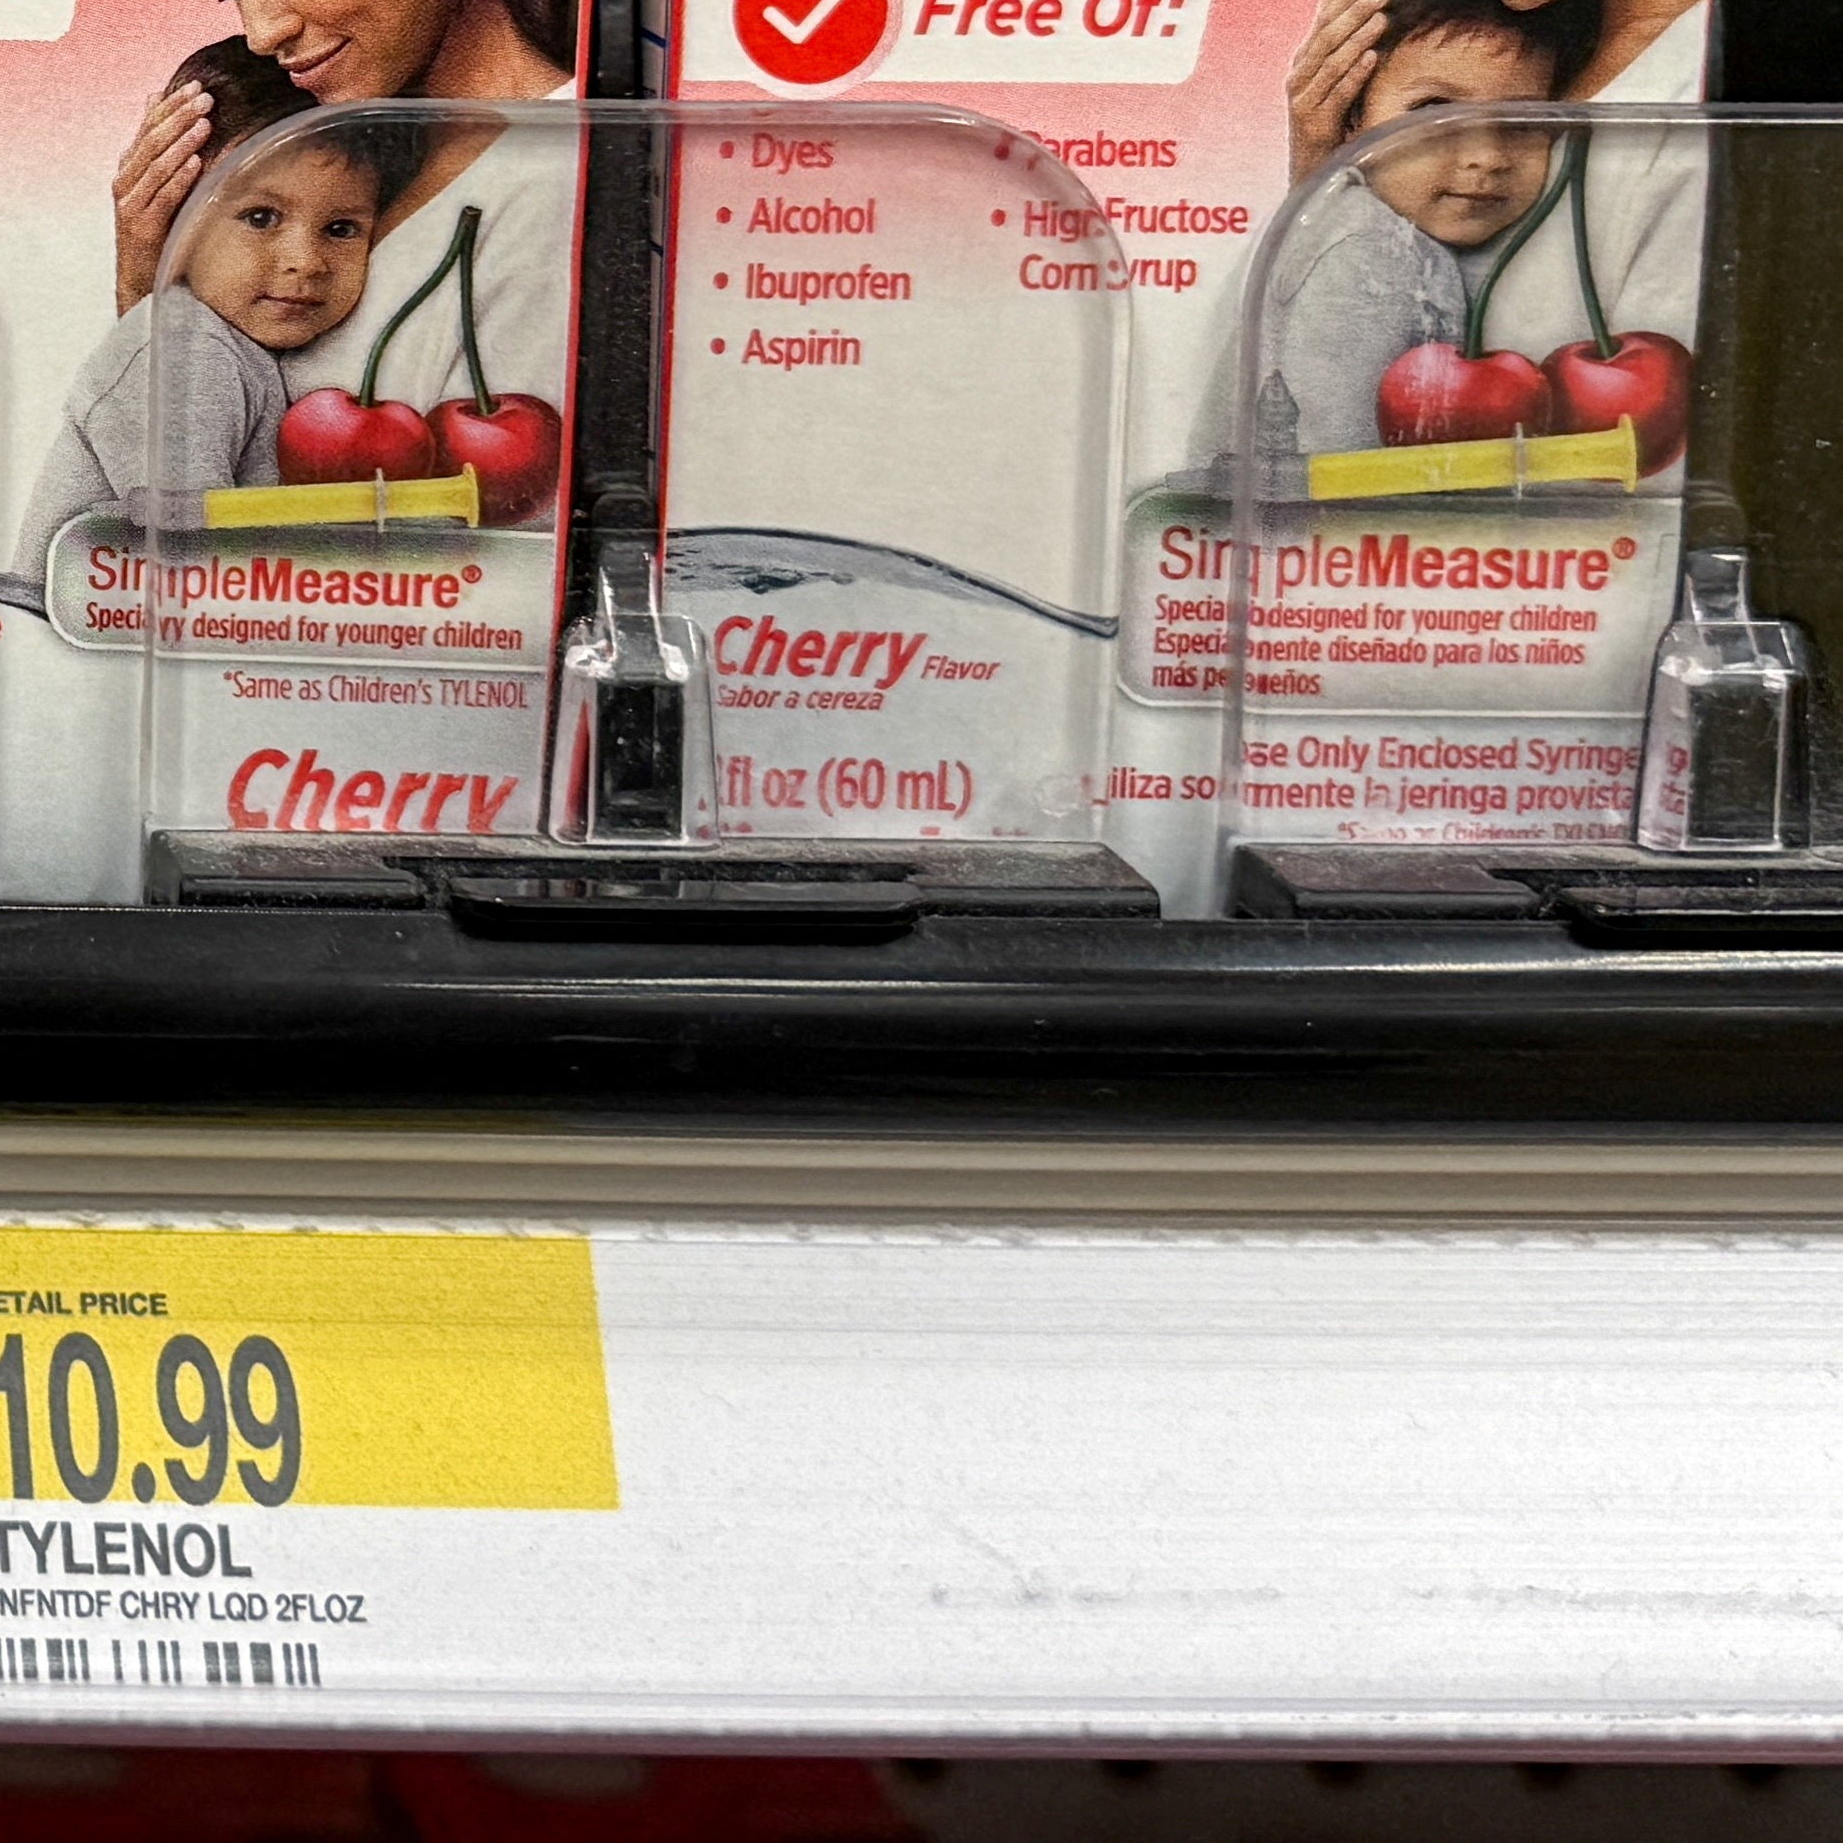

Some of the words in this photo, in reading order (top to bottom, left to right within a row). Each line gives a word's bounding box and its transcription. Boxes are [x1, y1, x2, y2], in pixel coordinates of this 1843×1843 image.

[751, 131, 835, 171] Dyes
[747, 198, 877, 235] Alcohol
[1105, 196, 1249, 235] Fructose
[745, 262, 912, 304] Ibuprofen
[741, 328, 862, 370] Aspirin
[1373, 603, 1405, 630] for
[1412, 608, 1503, 635] younger
[1509, 605, 1597, 632] children
[713, 615, 928, 690] Cherry
[920, 655, 1001, 681] Flavor
[298, 678, 322, 701] as
[784, 690, 799, 710] a
[806, 689, 885, 711] cereza
[762, 768, 809, 808] oz
[817, 757, 886, 818] (60
[896, 759, 973, 820] mL)
[79, 1291, 169, 1319] PRICE
[119, 1590, 201, 1621] CHRY
[208, 1591, 269, 1624] LQD
[275, 1592, 369, 1624] 2FLOZ
